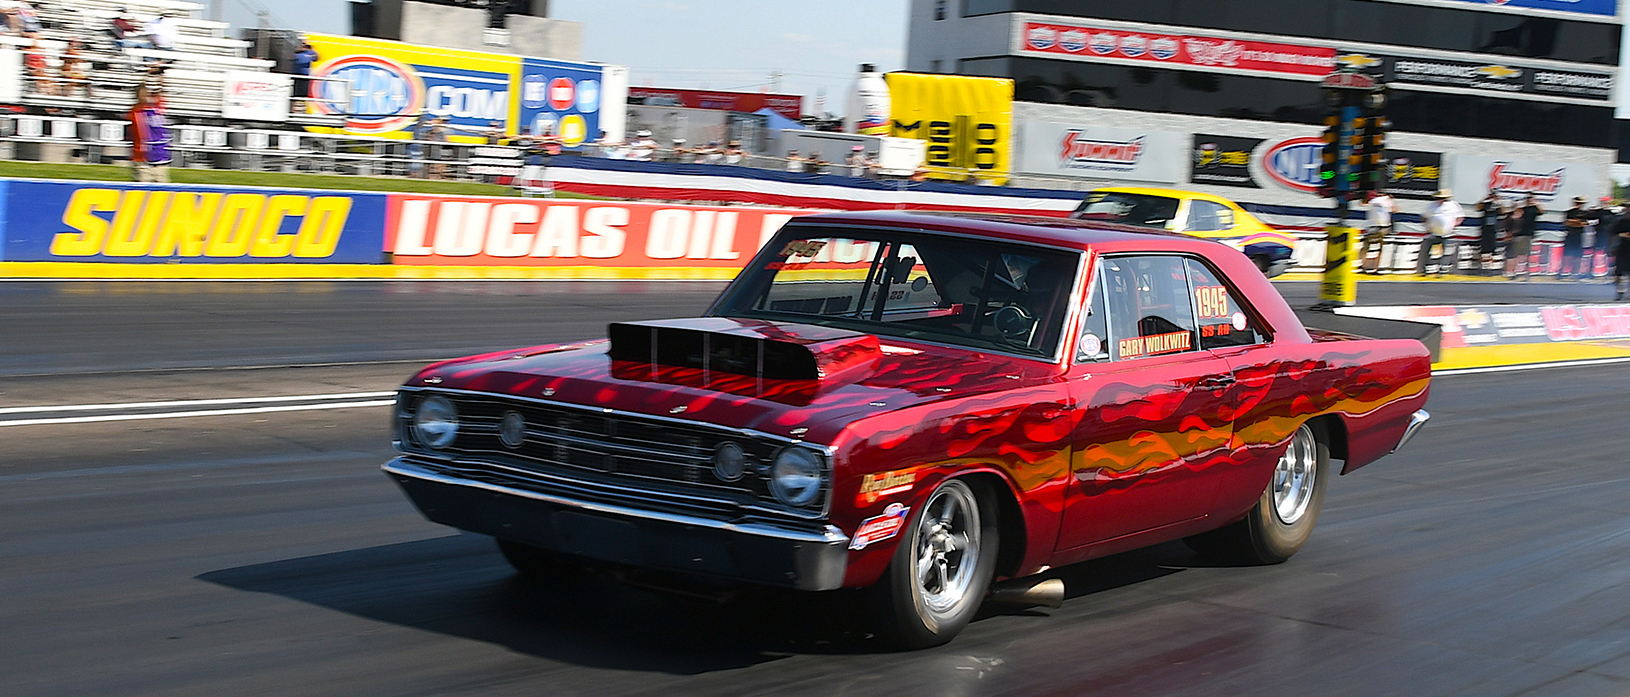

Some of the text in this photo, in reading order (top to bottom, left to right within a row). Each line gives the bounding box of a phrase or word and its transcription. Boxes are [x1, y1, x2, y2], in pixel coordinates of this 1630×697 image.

[50, 189, 352, 257] SUNOCO
[395, 200, 630, 258] LUCAS
[645, 208, 741, 260] OIL
[1195, 286, 1228, 318] 1945
[1119, 338, 1144, 358] GARY
[1145, 331, 1191, 354] WOLKWITZ
[1202, 325, 1214, 337] SS
